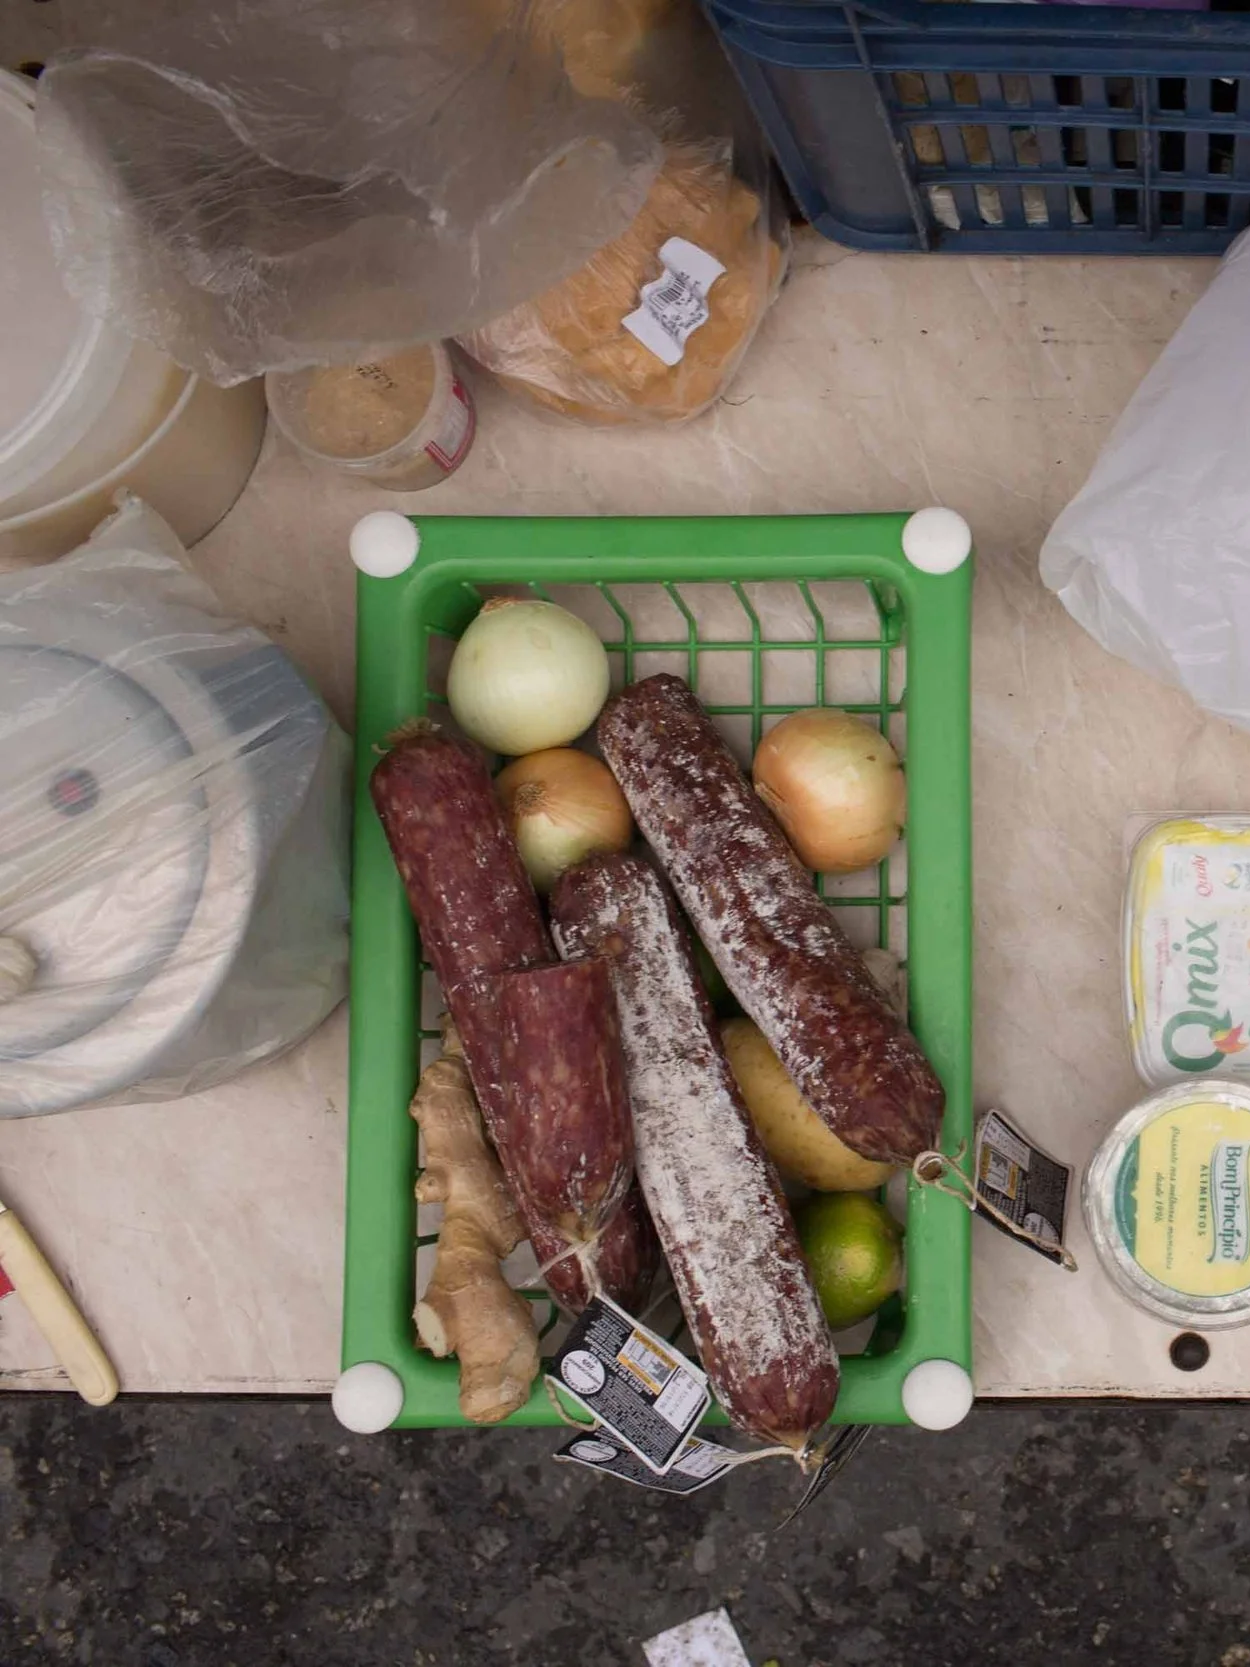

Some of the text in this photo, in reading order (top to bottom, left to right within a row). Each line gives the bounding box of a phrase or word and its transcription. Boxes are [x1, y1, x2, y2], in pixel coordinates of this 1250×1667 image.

[1189, 855, 1214, 897] Qualy
[1162, 917, 1236, 1073] Qmix
[1198, 1164, 1208, 1236] ALIMENTOS
